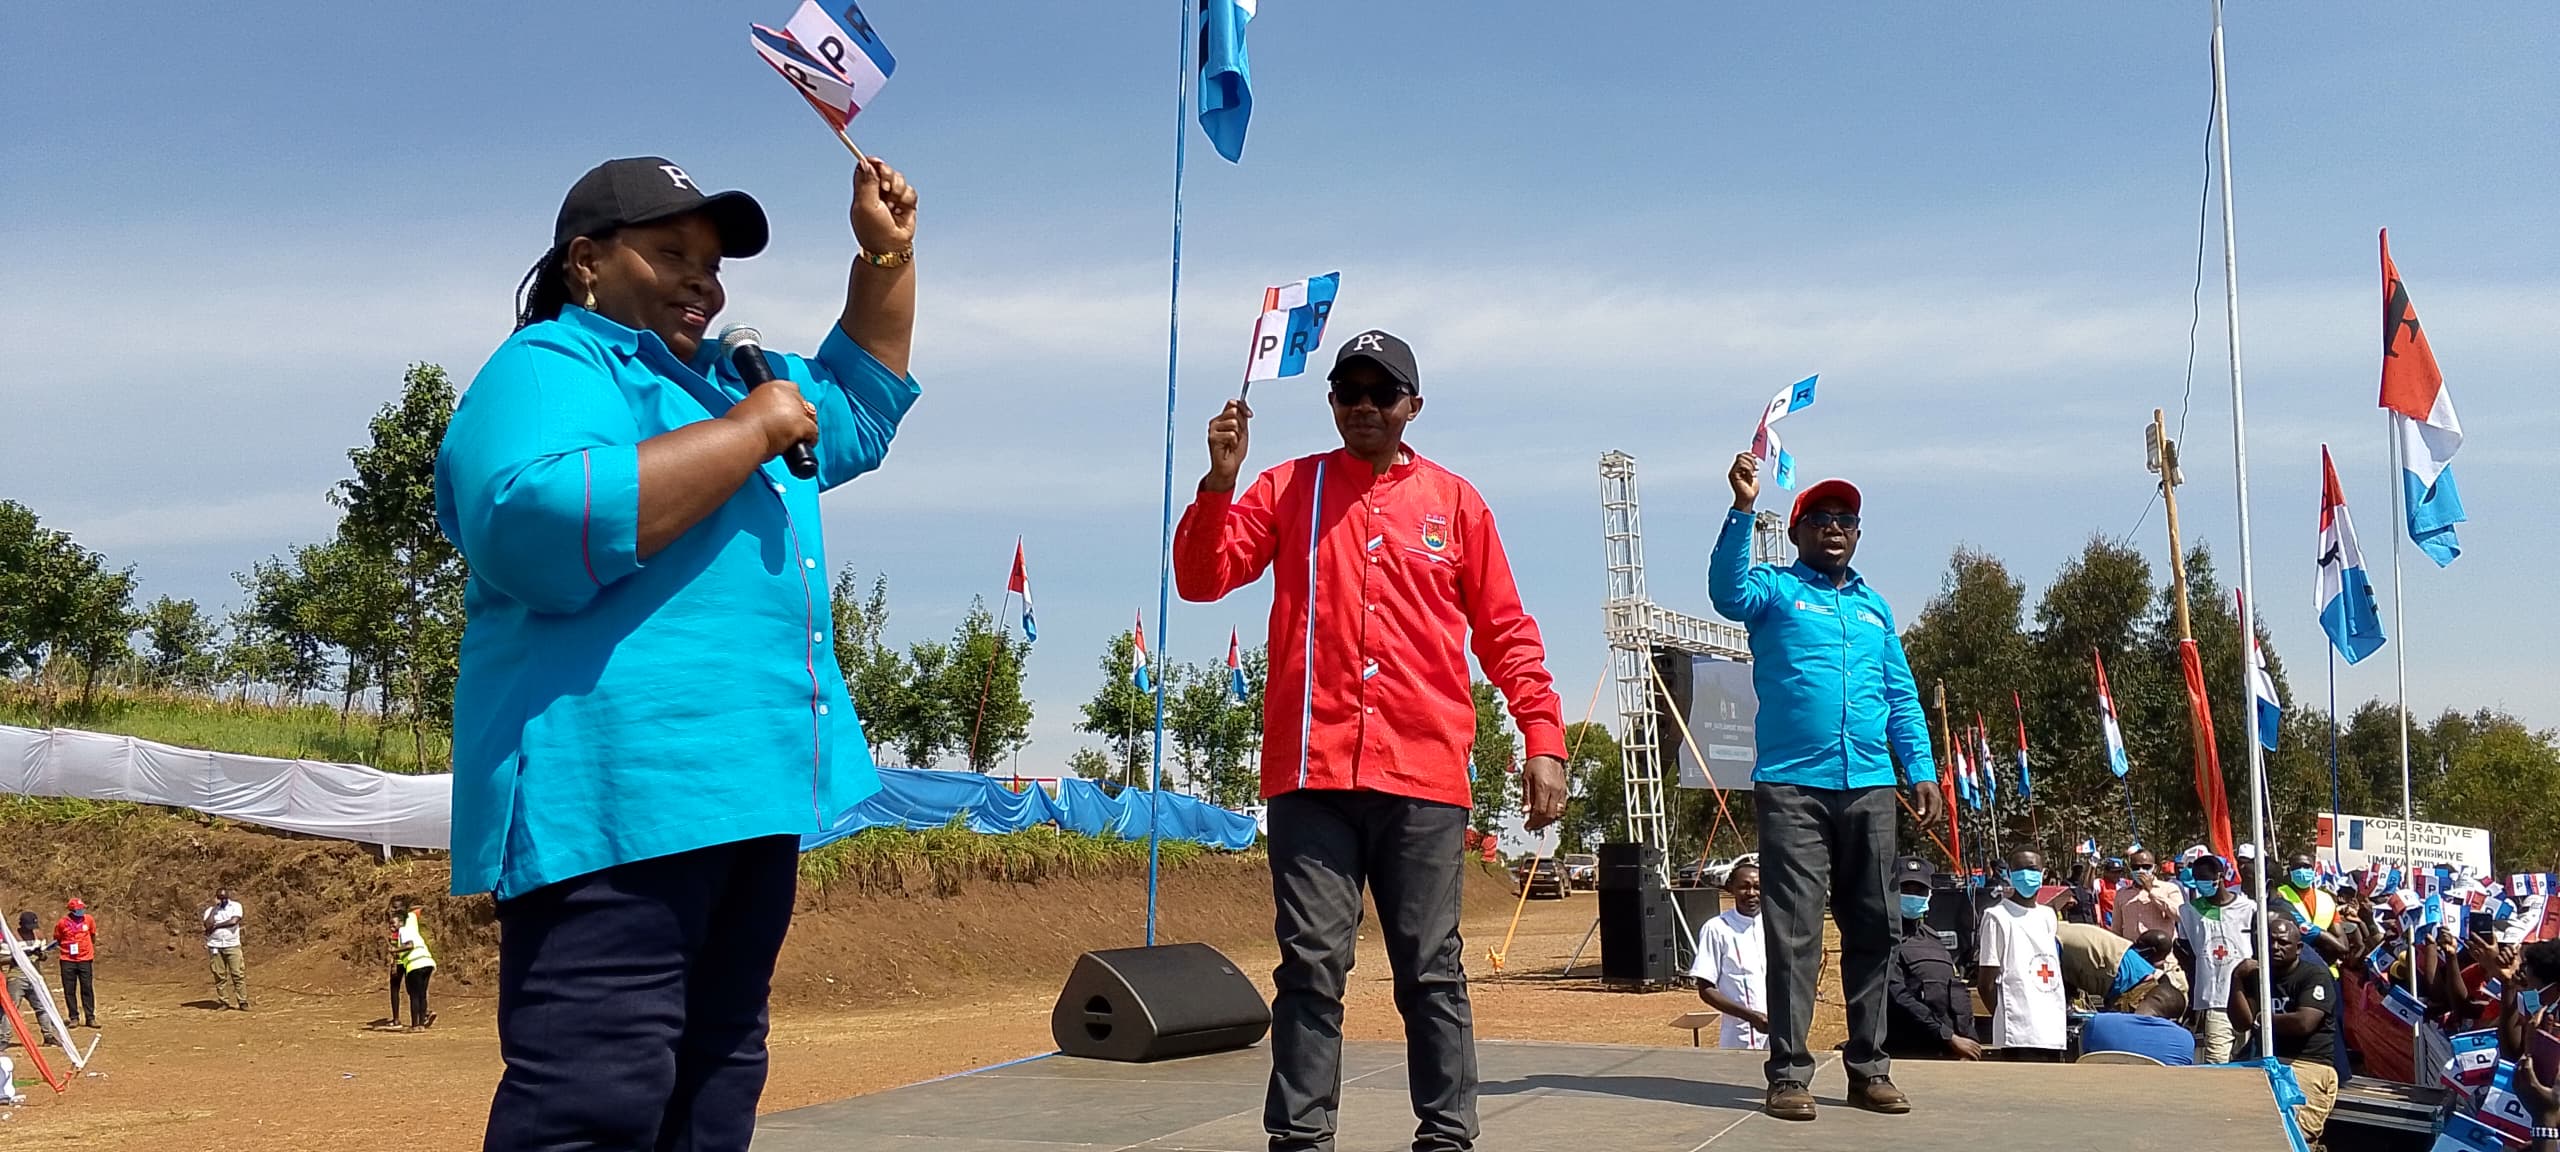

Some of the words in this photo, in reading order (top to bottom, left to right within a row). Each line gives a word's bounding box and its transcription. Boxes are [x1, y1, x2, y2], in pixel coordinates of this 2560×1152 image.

[818, 36, 846, 74] P
[1258, 335, 1278, 360] P
[1288, 332, 1309, 356] R
[1771, 398, 1786, 413] P
[2365, 818, 2473, 838] KOPERATIVE
[2428, 884, 2436, 893] P
[2428, 904, 2439, 914] R
[2399, 1008, 2409, 1019] P
[2476, 1054, 2491, 1064] P
[2504, 1099, 2524, 1118] P
